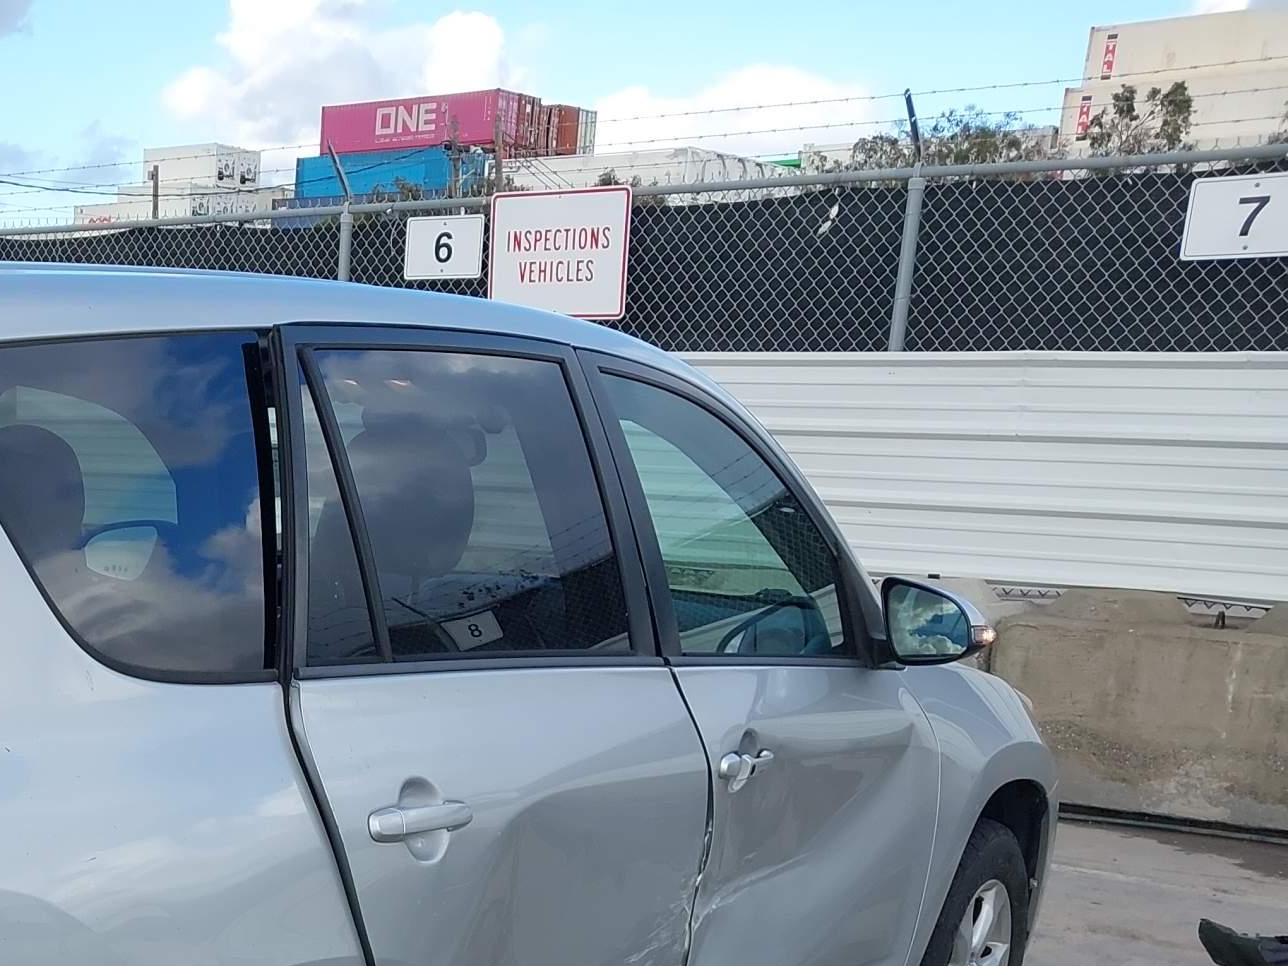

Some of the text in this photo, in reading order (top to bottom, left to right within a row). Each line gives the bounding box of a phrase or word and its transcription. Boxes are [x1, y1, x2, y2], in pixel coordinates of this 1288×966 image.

[1103, 42, 1117, 73] TAL
[375, 102, 437, 135] ONE
[1238, 196, 1271, 237] 7
[434, 231, 454, 263] 6
[506, 226, 611, 253] INSPECTIONS
[519, 259, 594, 284] VEHICLES
